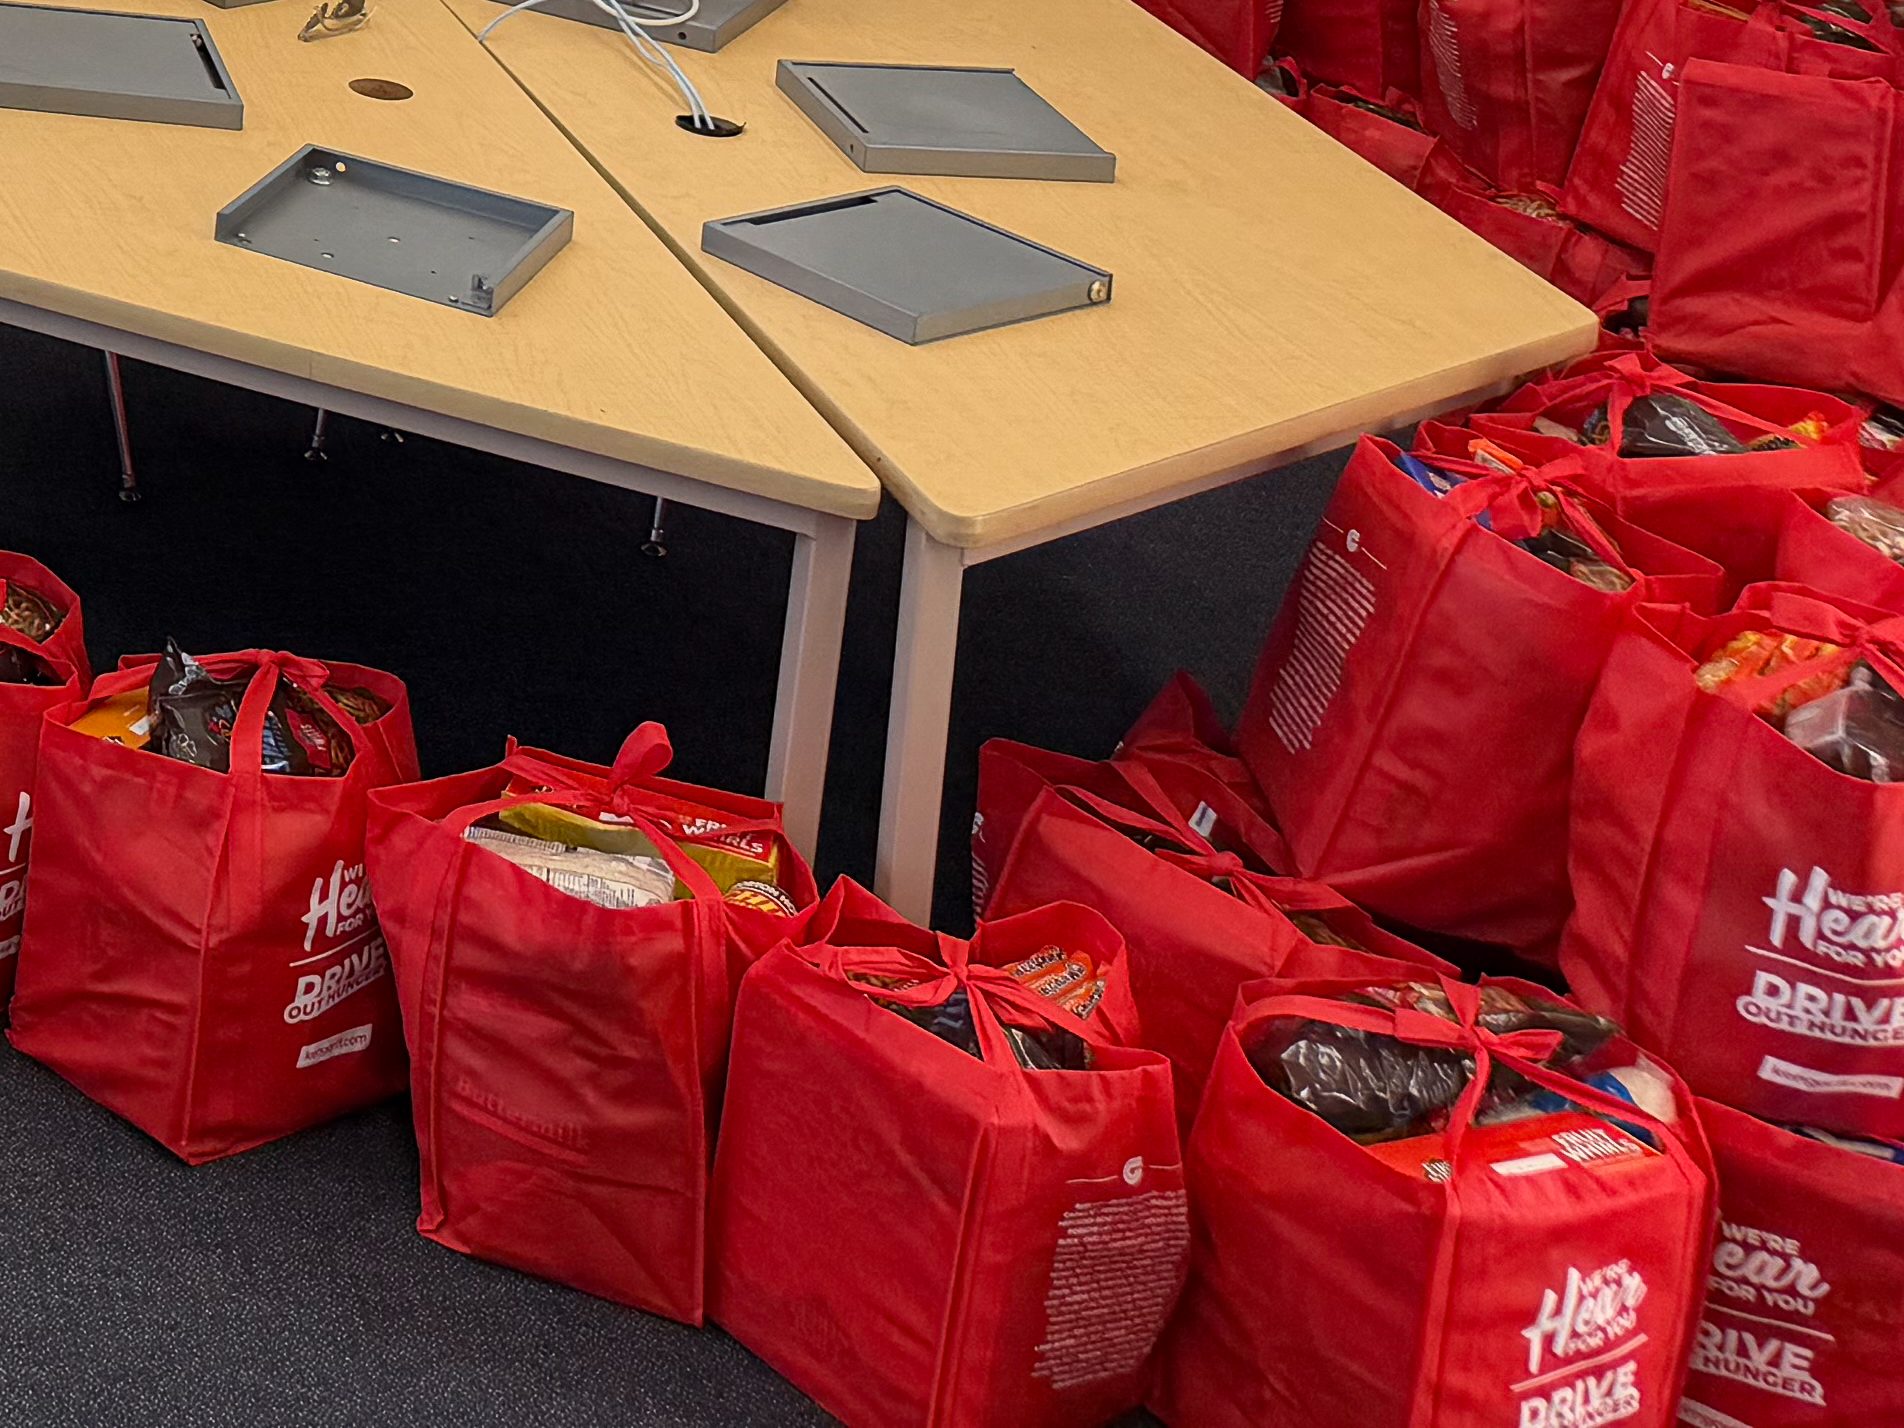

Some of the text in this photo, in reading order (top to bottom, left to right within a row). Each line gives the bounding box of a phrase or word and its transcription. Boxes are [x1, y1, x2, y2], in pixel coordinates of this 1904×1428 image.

[336, 915, 363, 935] FOR
[295, 937, 385, 1003] DRIVE
[288, 1000, 323, 1020] OUT
[1743, 1001, 1801, 1028] OUT
[1721, 1220, 1800, 1256] WE'RE
[1713, 1242, 1831, 1299] ear
[1521, 1266, 1648, 1374] Hear
[1761, 1288, 1815, 1316] YOU
[1697, 1320, 1815, 1377] RIVE
[1702, 1354, 1817, 1398] HUNGER
